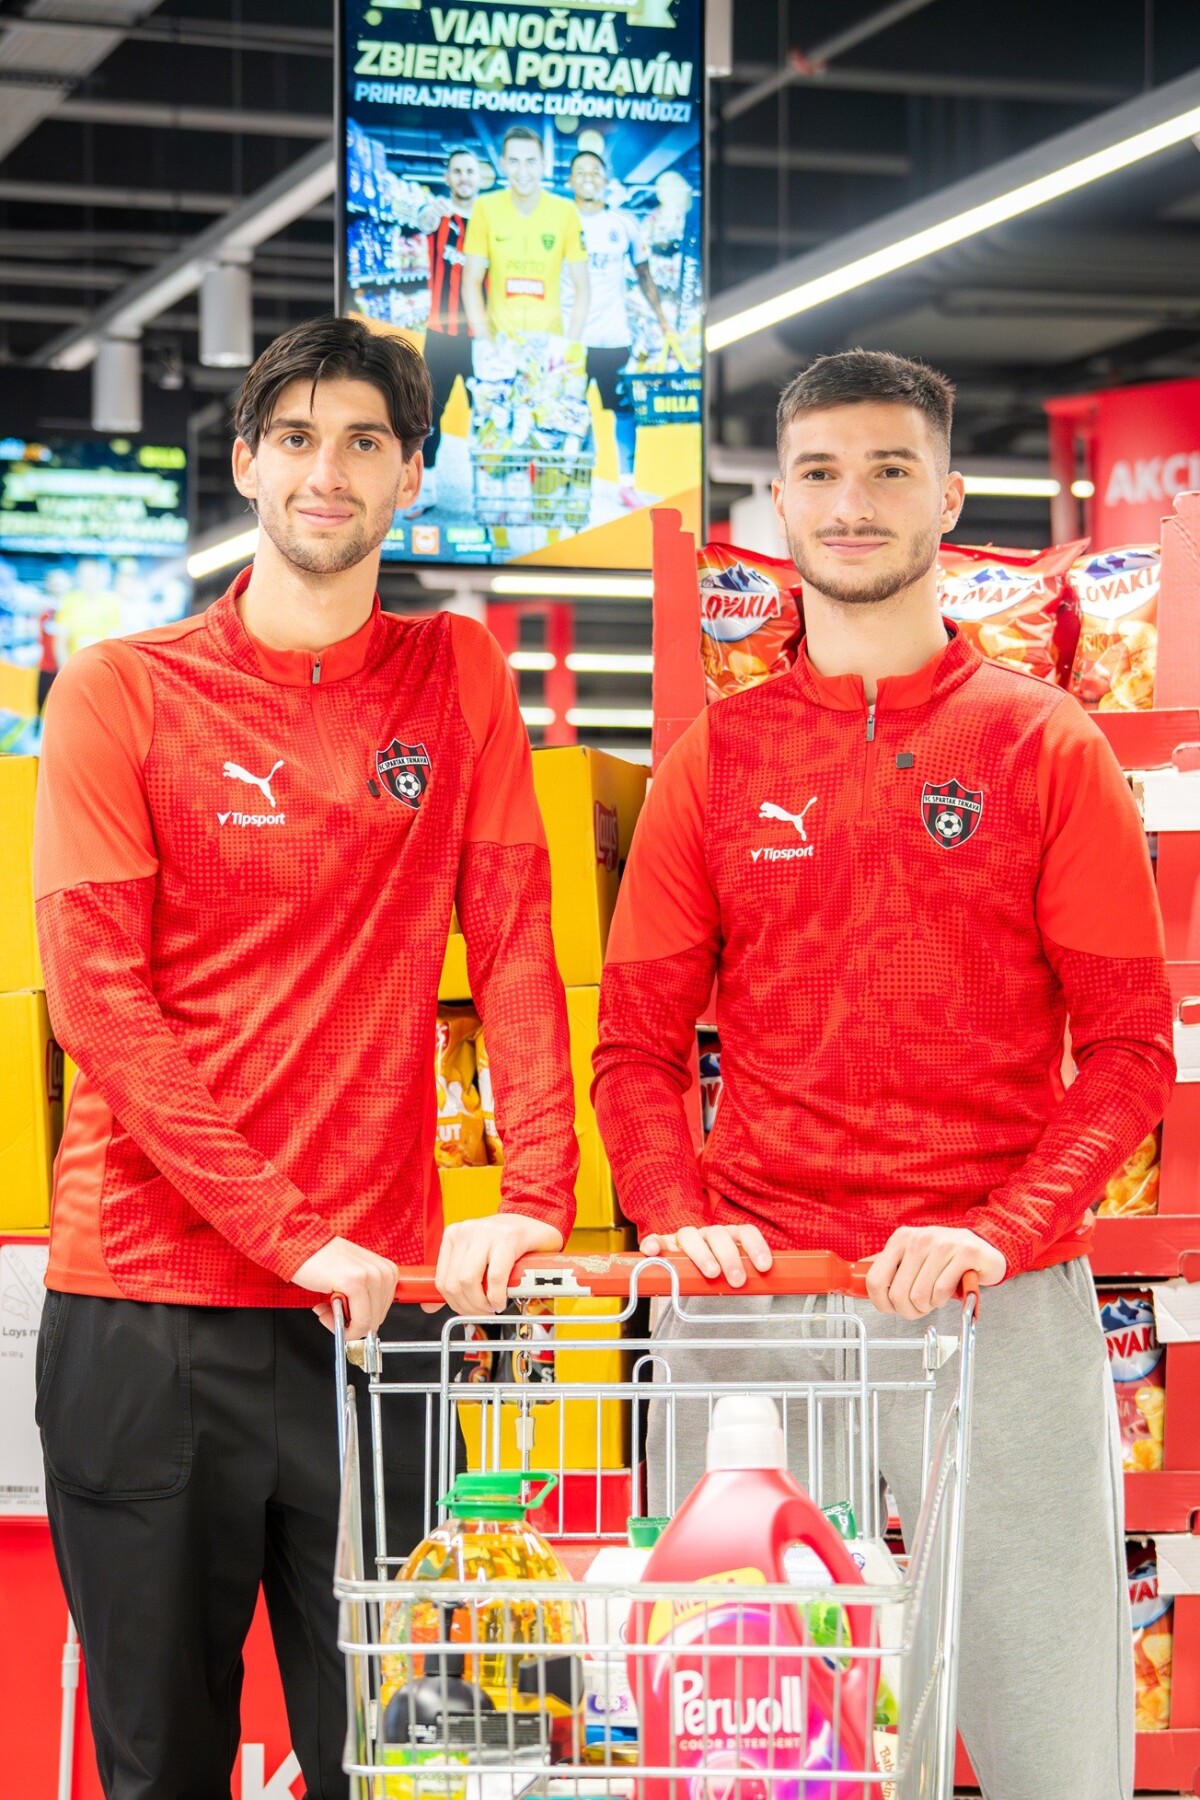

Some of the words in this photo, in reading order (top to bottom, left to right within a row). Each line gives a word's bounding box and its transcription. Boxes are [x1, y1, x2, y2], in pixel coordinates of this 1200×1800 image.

[430, 7, 619, 54] VIANOČNÁ
[353, 40, 513, 85] ZBIERKA
[515, 51, 693, 96] POTRAVÍN
[355, 81, 473, 110] PRIHRAJME
[472, 89, 544, 114] POMOC
[615, 98, 633, 119] V
[630, 96, 692, 122] NÚDZI
[653, 396, 698, 413] BILLA
[1080, 567, 1160, 602] OVAKI
[701, 594, 779, 620] OVAKIA
[932, 796, 956, 805] SPARTAK
[231, 812, 286, 828] Tipsport
[763, 845, 814, 862] Tipsport
[3, 1326, 27, 1339] Lays
[674, 1669, 803, 1737] Perwoll
